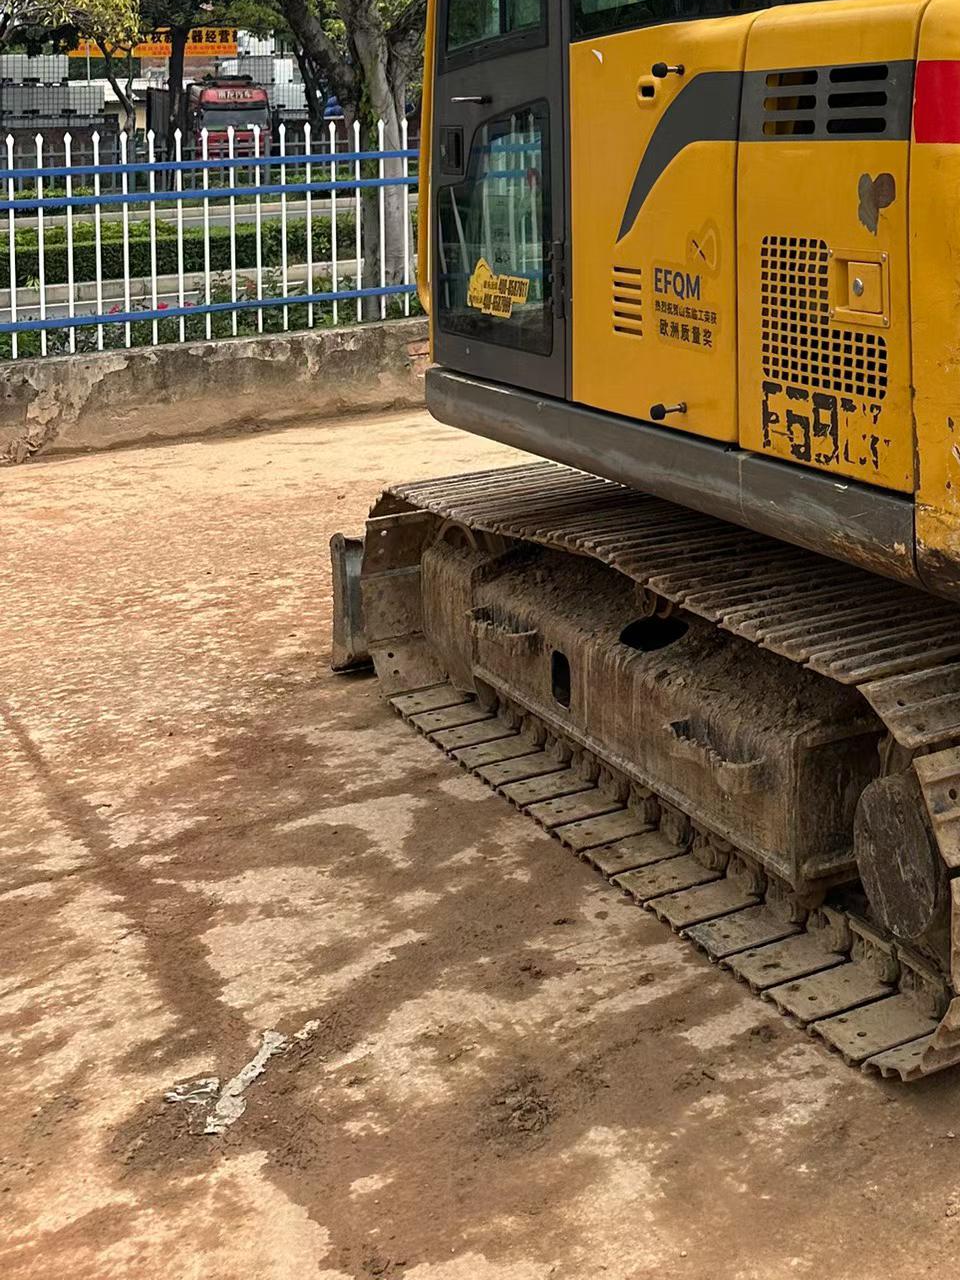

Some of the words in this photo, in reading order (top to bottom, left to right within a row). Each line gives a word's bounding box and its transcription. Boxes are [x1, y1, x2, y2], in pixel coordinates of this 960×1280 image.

[655, 267, 700, 300] EFQM
[659, 319, 713, 349] 欧洲质量奖
